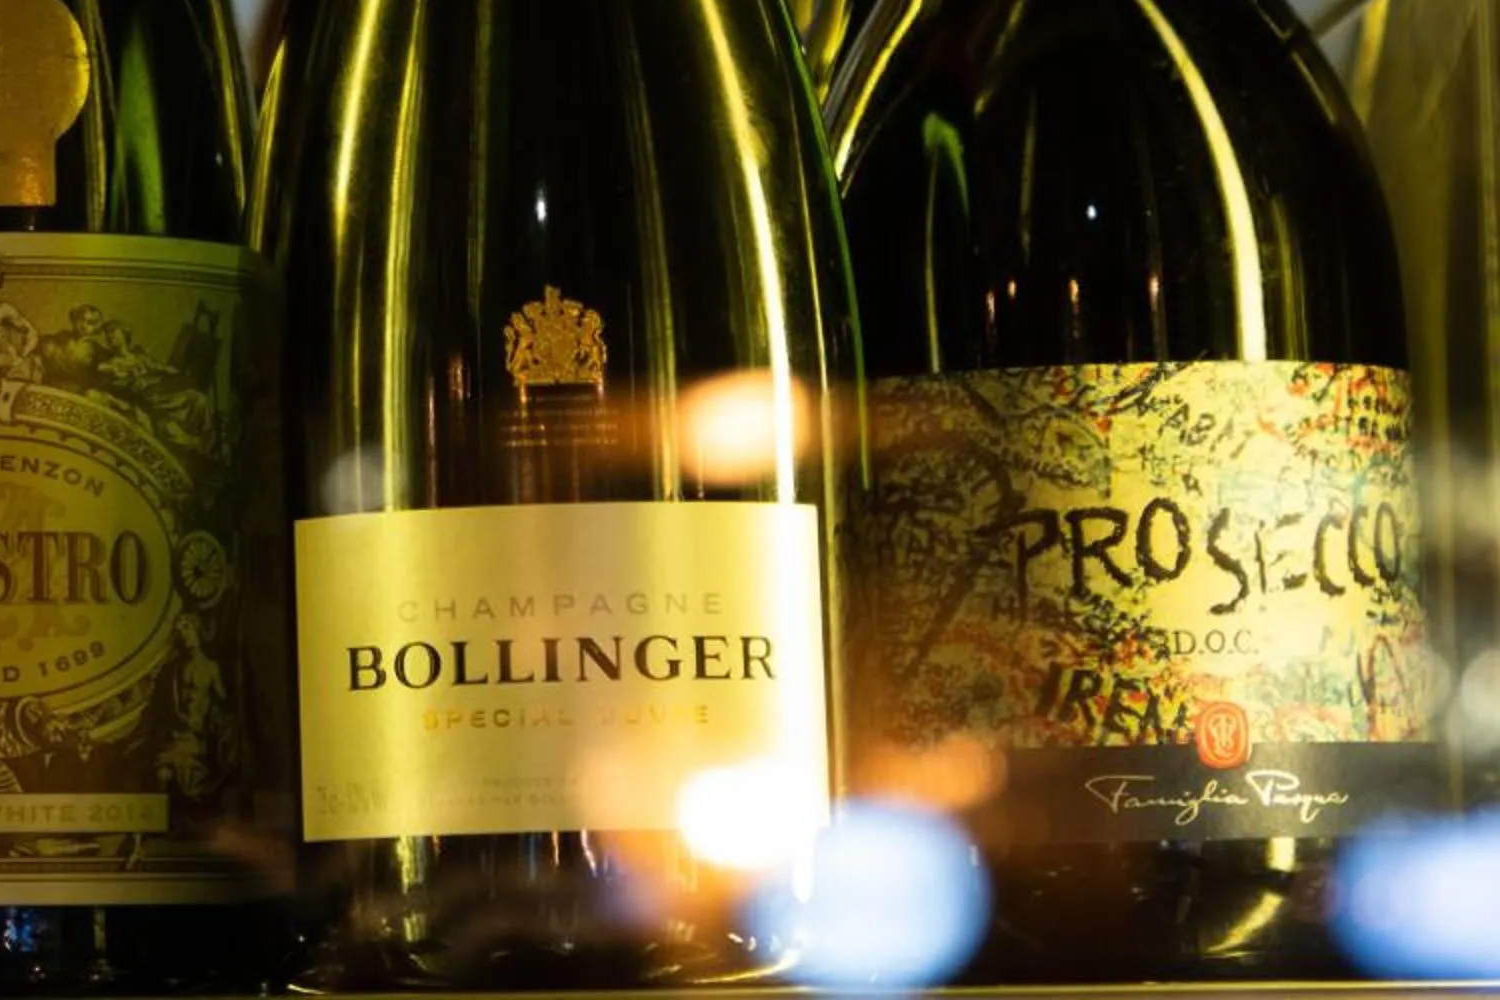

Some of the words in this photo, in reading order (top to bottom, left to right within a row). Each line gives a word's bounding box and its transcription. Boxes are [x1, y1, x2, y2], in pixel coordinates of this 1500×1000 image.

[1004, 497, 1402, 616] PROSECCO
[398, 592, 724, 622] CHAMPAGNE
[347, 635, 777, 693] BOLLINGER
[1172, 629, 1261, 656] D.O.C.
